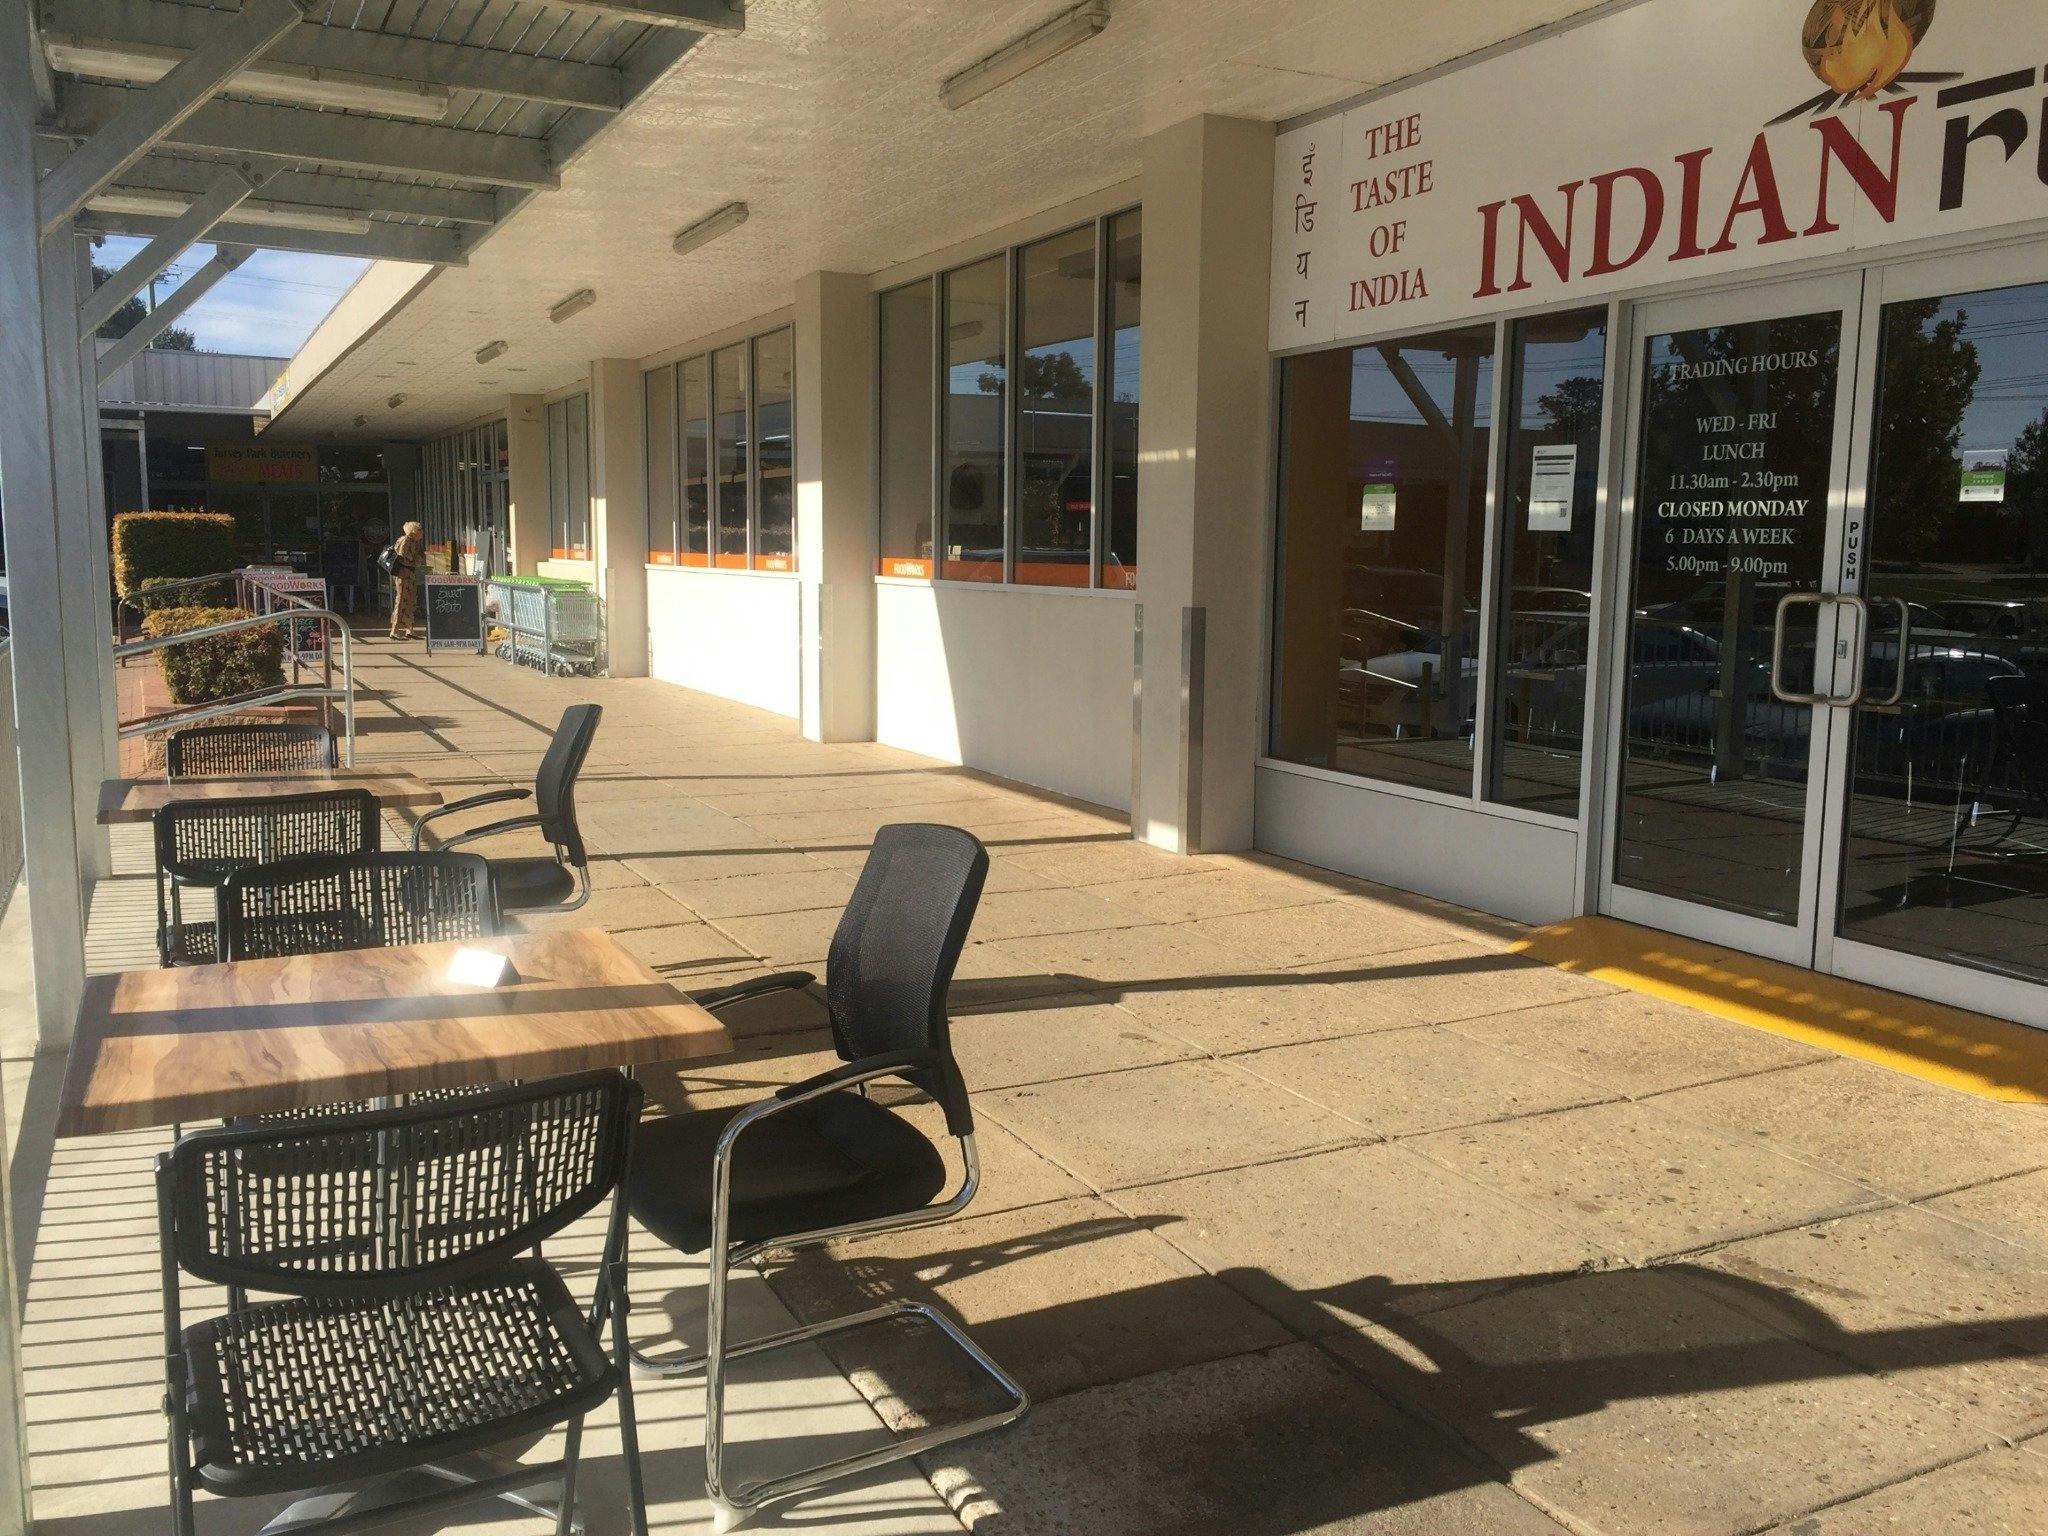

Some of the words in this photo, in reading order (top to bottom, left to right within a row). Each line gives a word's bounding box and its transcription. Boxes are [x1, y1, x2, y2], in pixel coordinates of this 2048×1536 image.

[1366, 113, 1422, 160] THE
[1350, 160, 1434, 213] TASTE
[1472, 96, 1918, 298] INDIAN
[1369, 220, 1407, 258] OF
[1348, 267, 1429, 312] INDIA
[1670, 357, 1748, 381] TRADING
[1750, 349, 1819, 373] HOURS
[1696, 416, 1735, 434] WED
[1748, 412, 1778, 430] FRI
[1702, 443, 1766, 462] LUNCH
[1669, 474, 1730, 491] 11.30am
[1741, 471, 1799, 492] 2.30pm
[1658, 501, 1724, 519] CLOSED
[1727, 499, 1810, 517] MONDAY
[1665, 529, 1674, 545] 6
[1682, 528, 1726, 545] DAYS
[1727, 528, 1740, 545] A
[1742, 527, 1795, 545] WEEK
[1847, 521, 1859, 580] PUSH
[1666, 555, 1720, 576] 5.00pm
[1730, 556, 1788, 578] 9.00pm
